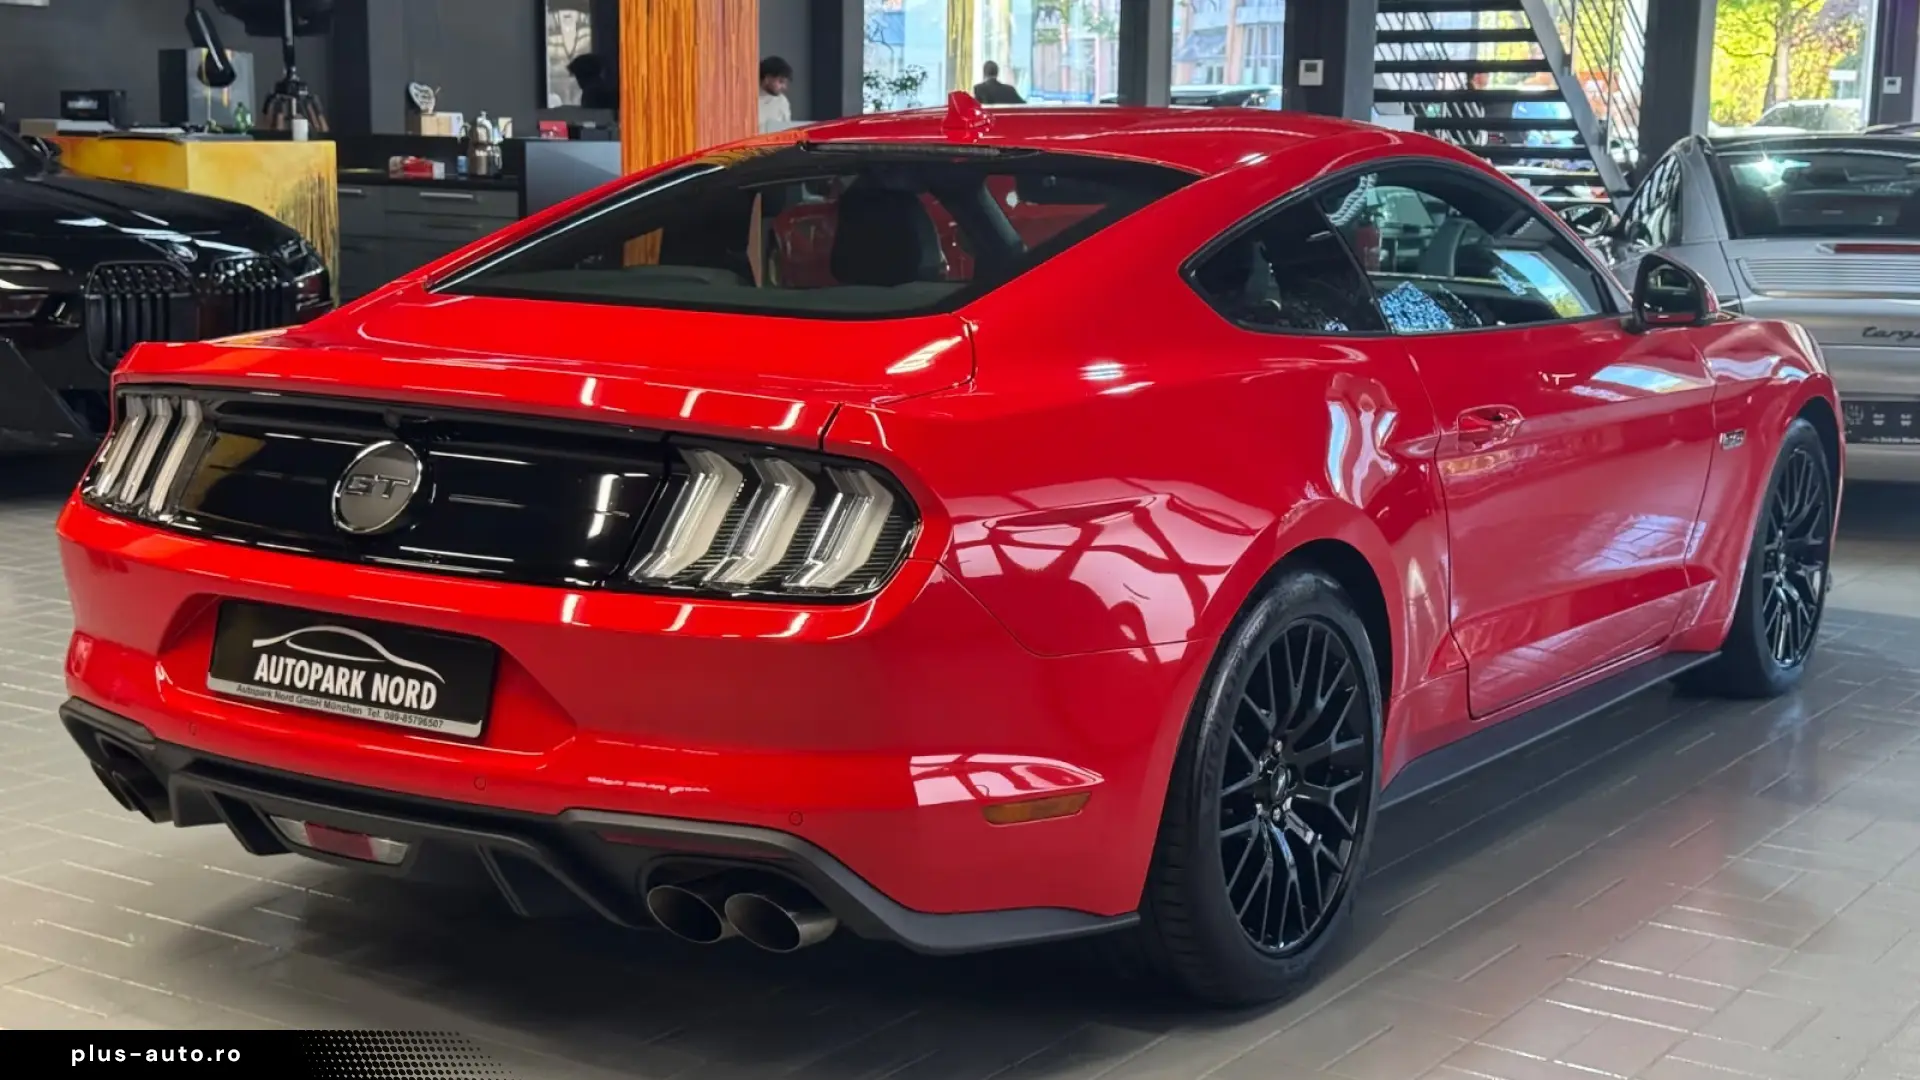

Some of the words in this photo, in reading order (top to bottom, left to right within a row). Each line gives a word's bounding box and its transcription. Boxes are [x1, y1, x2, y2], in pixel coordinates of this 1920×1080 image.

[345, 473, 410, 499] GT
[253, 653, 366, 699] AUTOPARK
[371, 673, 437, 711] NORD
[236, 684, 273, 697] Autopark
[275, 691, 295, 703] Nord
[296, 695, 321, 707] GmbH
[323, 700, 362, 715] München
[367, 707, 381, 718] Tel.
